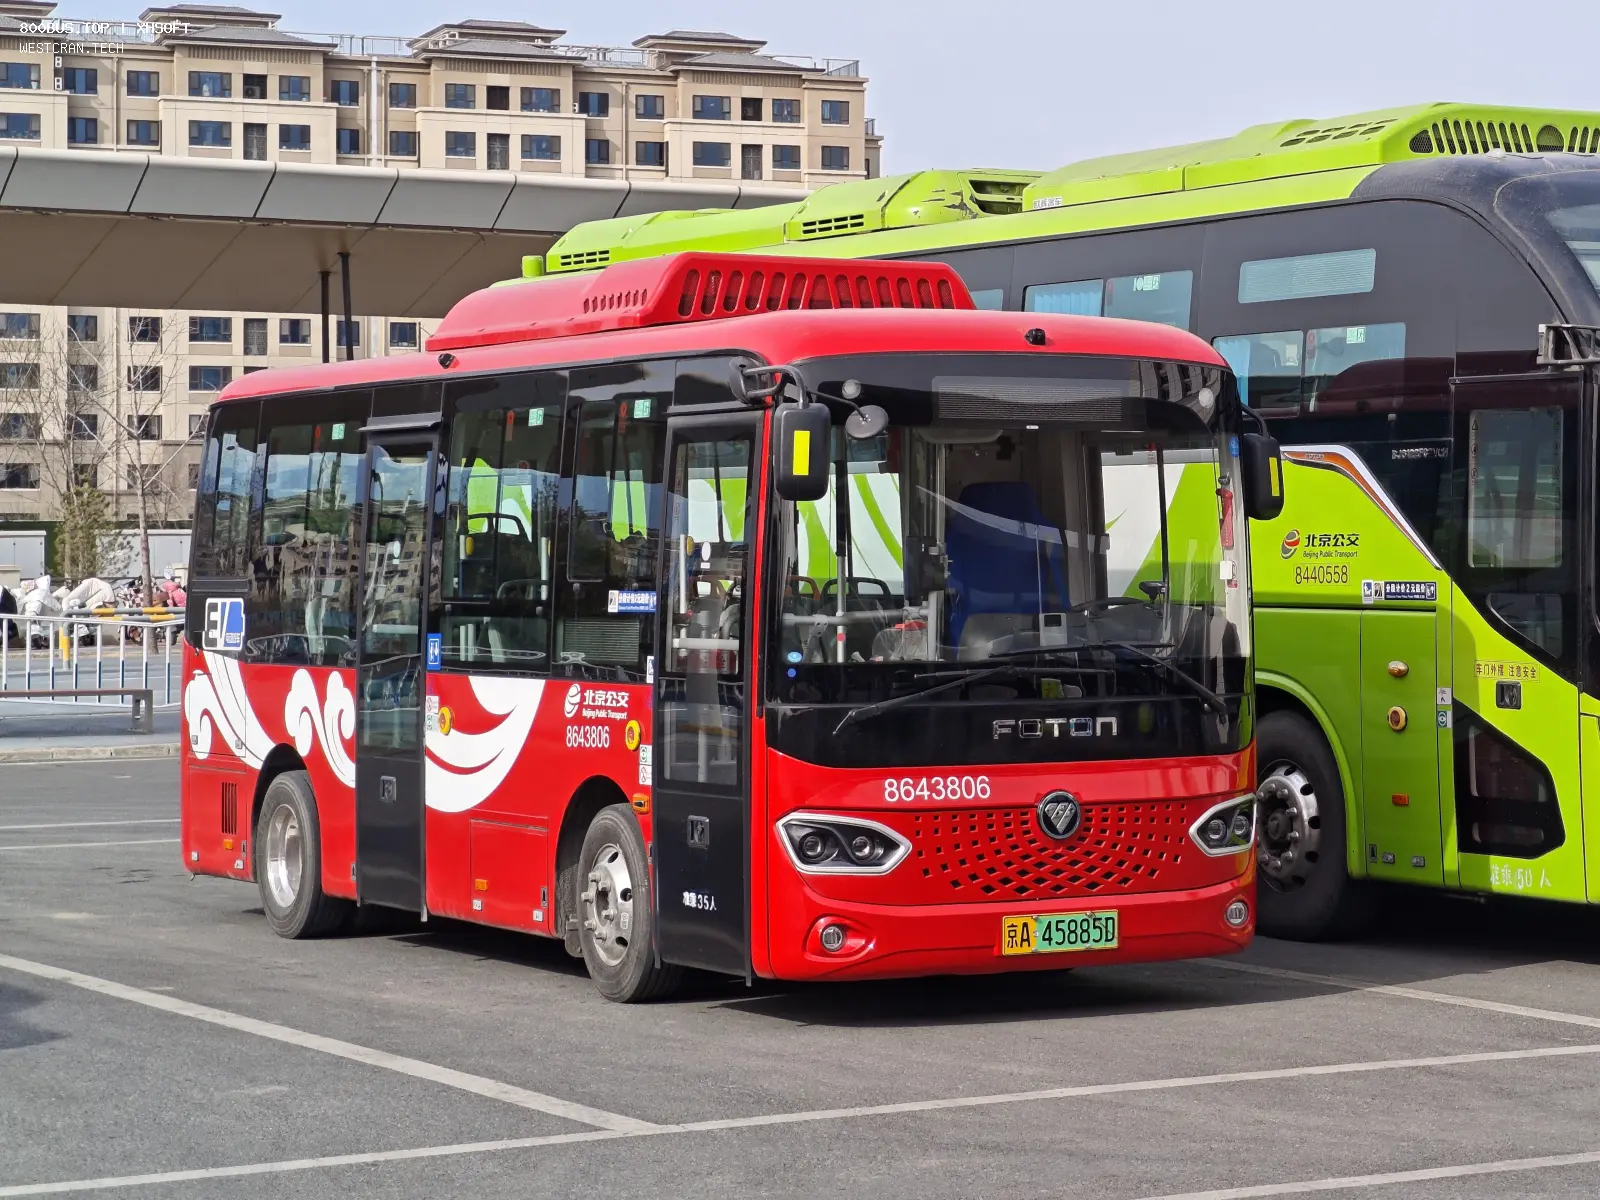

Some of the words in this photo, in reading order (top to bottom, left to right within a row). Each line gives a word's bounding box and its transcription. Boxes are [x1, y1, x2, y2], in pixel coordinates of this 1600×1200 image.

[1304, 533, 1360, 547] 北京公交
[1303, 551, 1319, 559] Beijing
[1335, 550, 1358, 558] Transport
[1295, 565, 1349, 585] 8440558
[1509, 665, 1537, 678] 注意安全
[583, 689, 630, 708] 北京公交
[566, 725, 610, 748] 8643806
[993, 717, 1118, 739] FOTON
[884, 776, 991, 802] 8643806
[1006, 921, 1031, 949] 京A
[1041, 916, 1116, 947] 45885D
